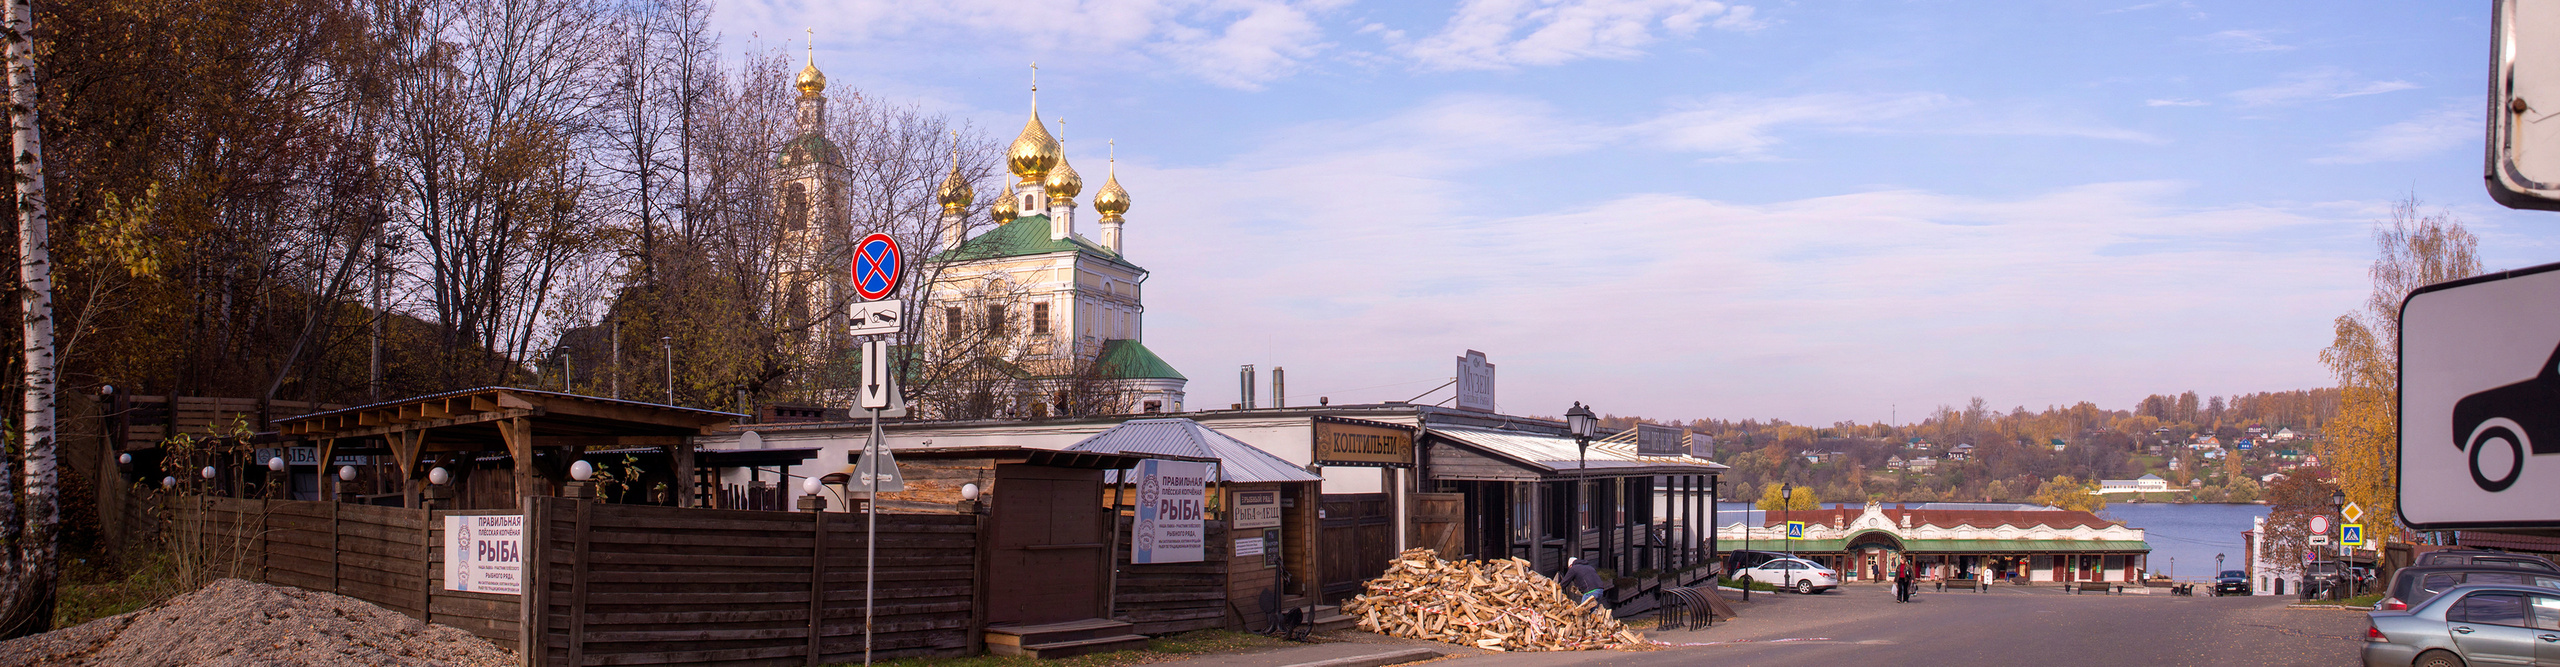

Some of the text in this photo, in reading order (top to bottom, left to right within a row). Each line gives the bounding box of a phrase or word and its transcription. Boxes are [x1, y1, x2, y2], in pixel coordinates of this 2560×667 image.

[1333, 432, 1397, 454] КОПТИЛЬНИ
[1162, 476, 1202, 486] ПРАВИЛЬНАЯ
[1160, 499, 1201, 520] РЫБА
[478, 516, 521, 526] ПРАВИЛЬНАЯ
[478, 540, 519, 562] РЫБА
